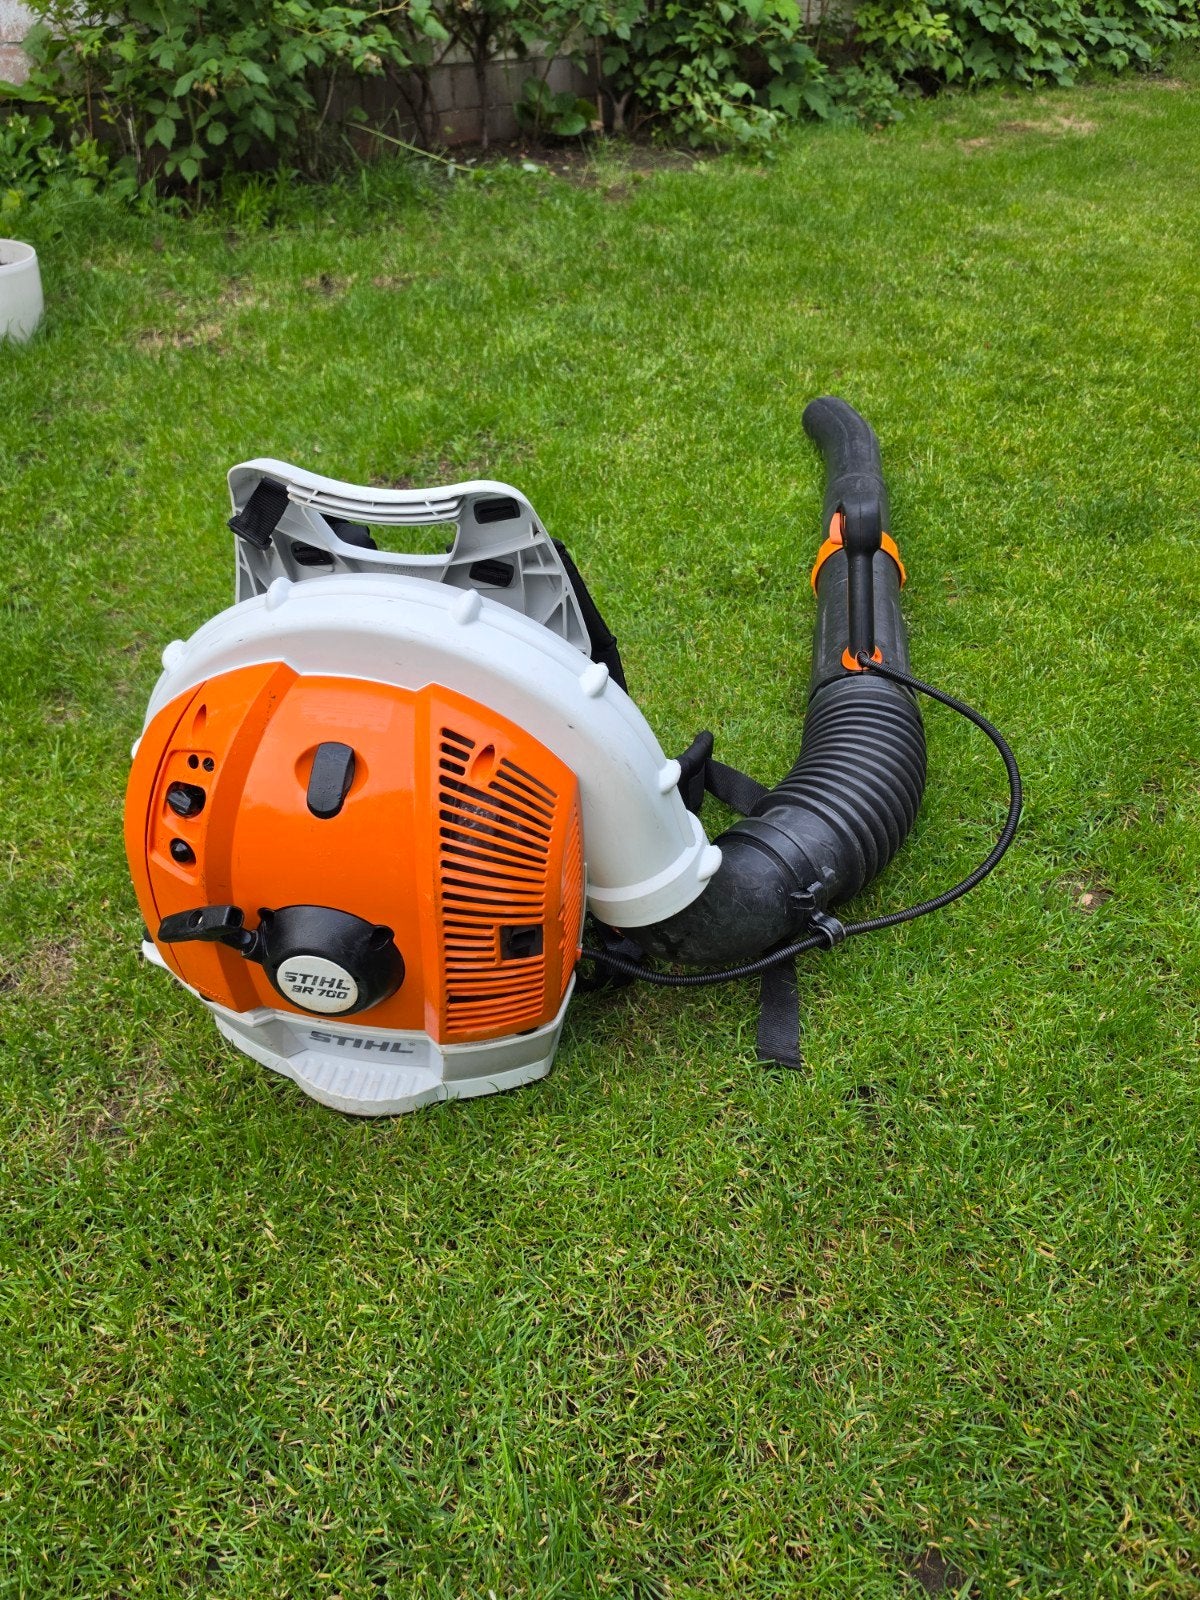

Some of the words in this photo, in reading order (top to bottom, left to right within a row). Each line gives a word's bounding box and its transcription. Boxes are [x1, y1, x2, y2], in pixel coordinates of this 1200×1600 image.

[284, 972, 350, 991] STIHL
[317, 988, 348, 999] 700
[309, 1030, 414, 1054] STIHL
